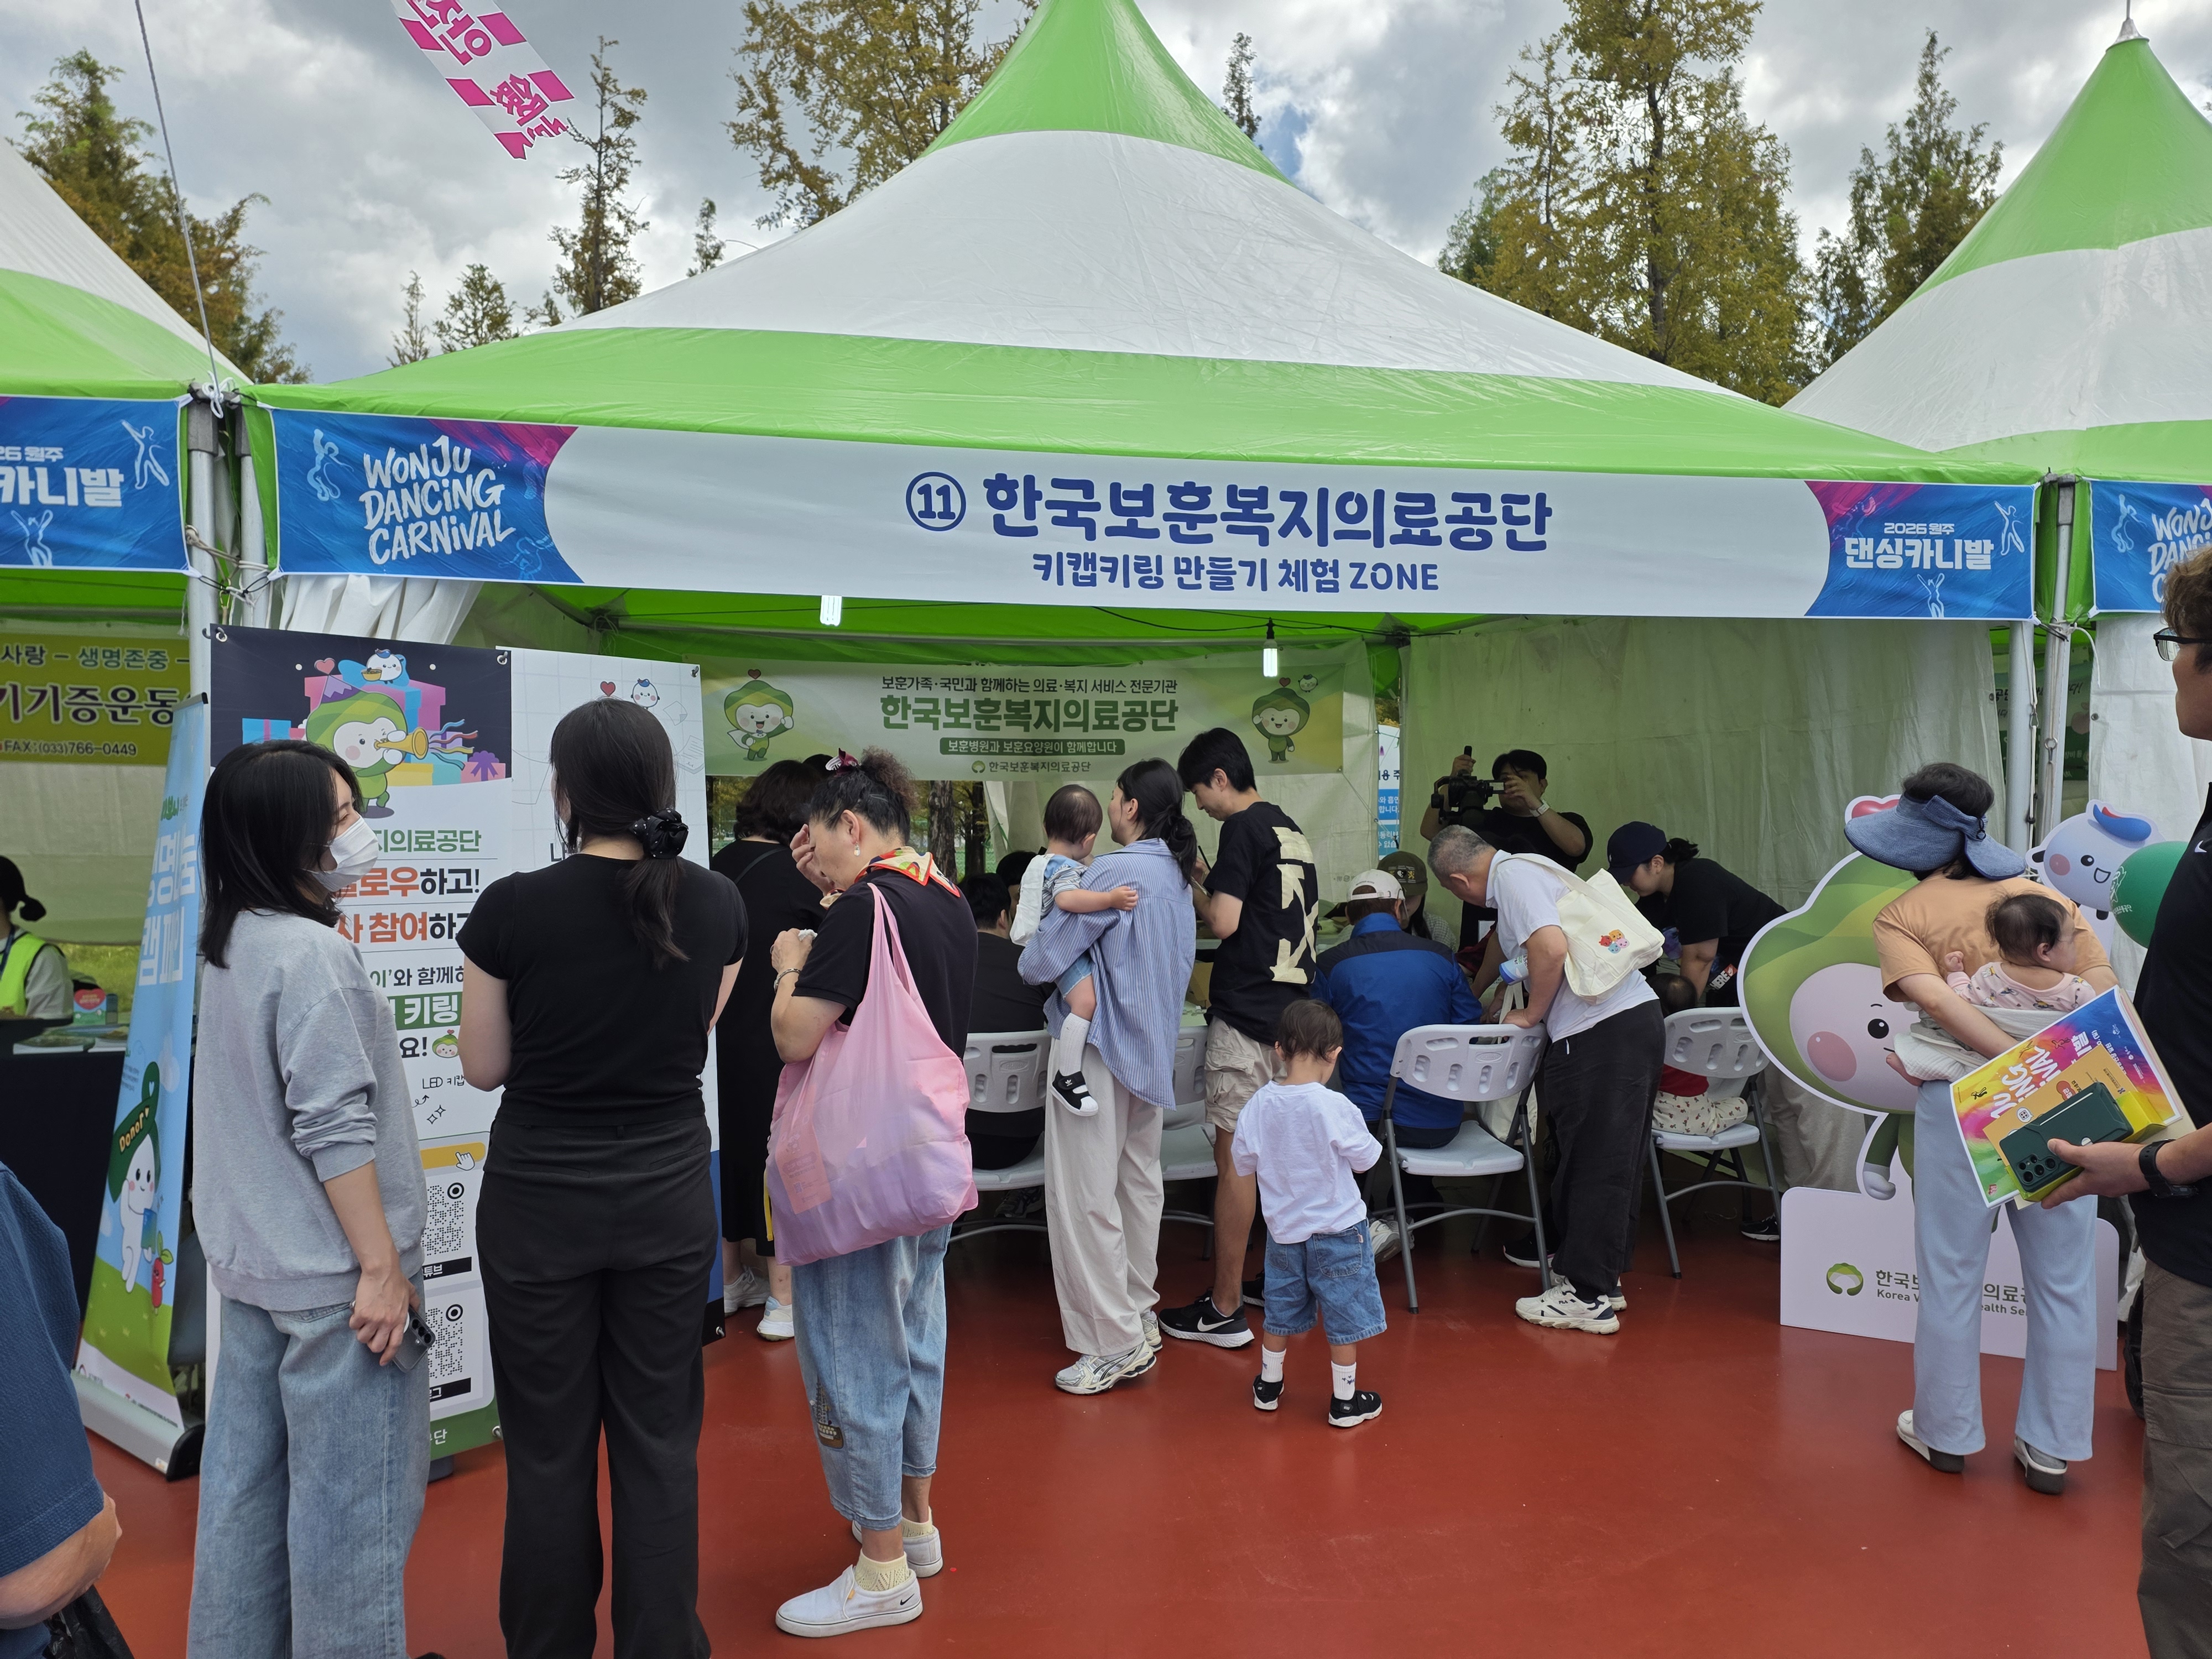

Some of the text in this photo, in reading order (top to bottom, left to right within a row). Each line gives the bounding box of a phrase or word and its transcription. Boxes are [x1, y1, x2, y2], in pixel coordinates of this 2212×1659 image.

[25, 446, 64, 462] 원주
[363, 435, 471, 489] WONJU
[0, 466, 124, 507] 카니발
[983, 473, 1553, 551] 한국보훈복지의료공단
[1928, 523, 1955, 535] 원주
[1844, 538, 1994, 570] 댄싱카니발
[1032, 551, 1440, 593] 키캡키링 만들기 체험 ZONE
[1, 645, 46, 666] 사랑
[78, 648, 168, 670] 생명존중
[980, 677, 1030, 693] 함께하는
[1091, 680, 1126, 693] 서비스
[1129, 679, 1178, 694] 전문기관
[880, 695, 1179, 733] 한국보훈복지의료공단
[948, 740, 1117, 754] 보훈병원과 보훈요양원이 함께합니다
[989, 760, 1091, 773] 한국보훈복지의료공단
[335, 866, 480, 898] 로우하고!
[404, 995, 458, 1025] 키링
[399, 1036, 428, 1058] 요!
[422, 1074, 465, 1089] LED 키캡
[1877, 1289, 1910, 1302] Korea
